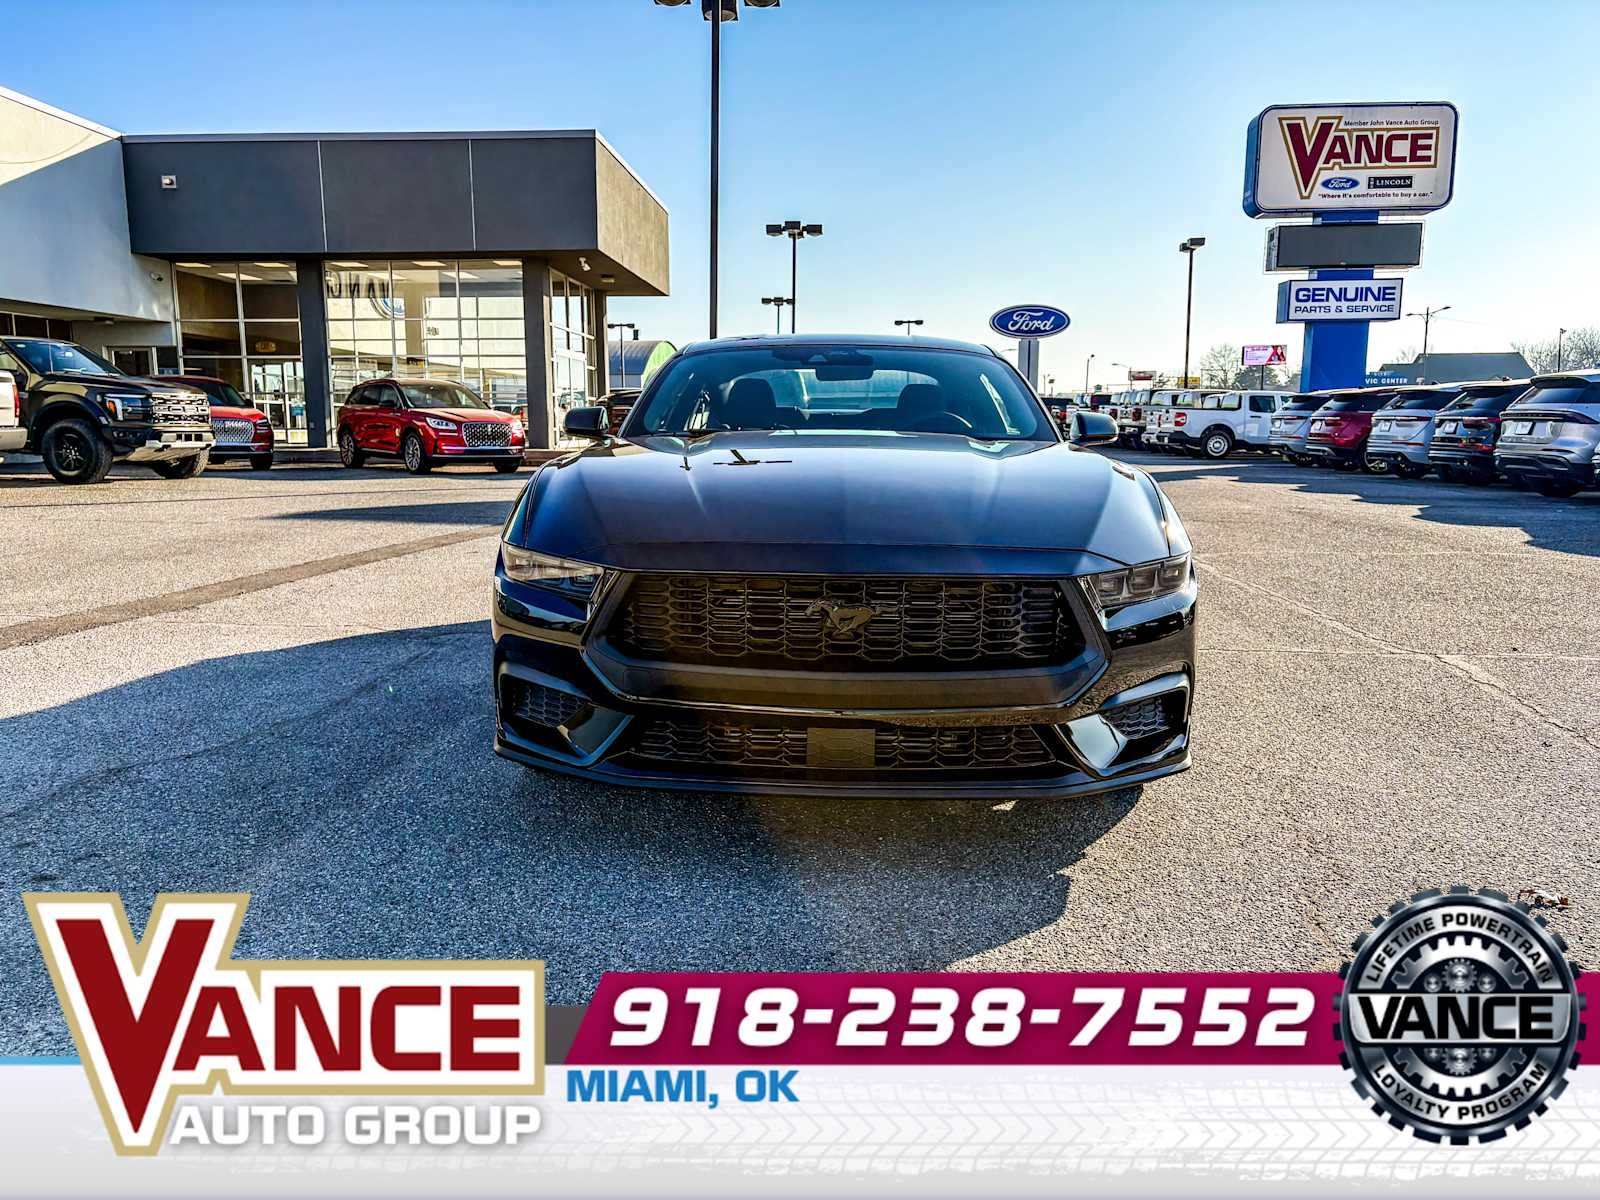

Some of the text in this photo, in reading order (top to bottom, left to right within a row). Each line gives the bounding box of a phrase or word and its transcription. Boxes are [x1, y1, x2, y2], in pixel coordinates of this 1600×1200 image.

[1286, 122, 1434, 193] VANCE
[1328, 178, 1353, 189] Ford
[1376, 179, 1412, 187] LINCOLN
[1294, 286, 1396, 303] GENUINE
[1294, 304, 1395, 314] PARTS & SERVICE
[1008, 311, 1056, 331] Ford
